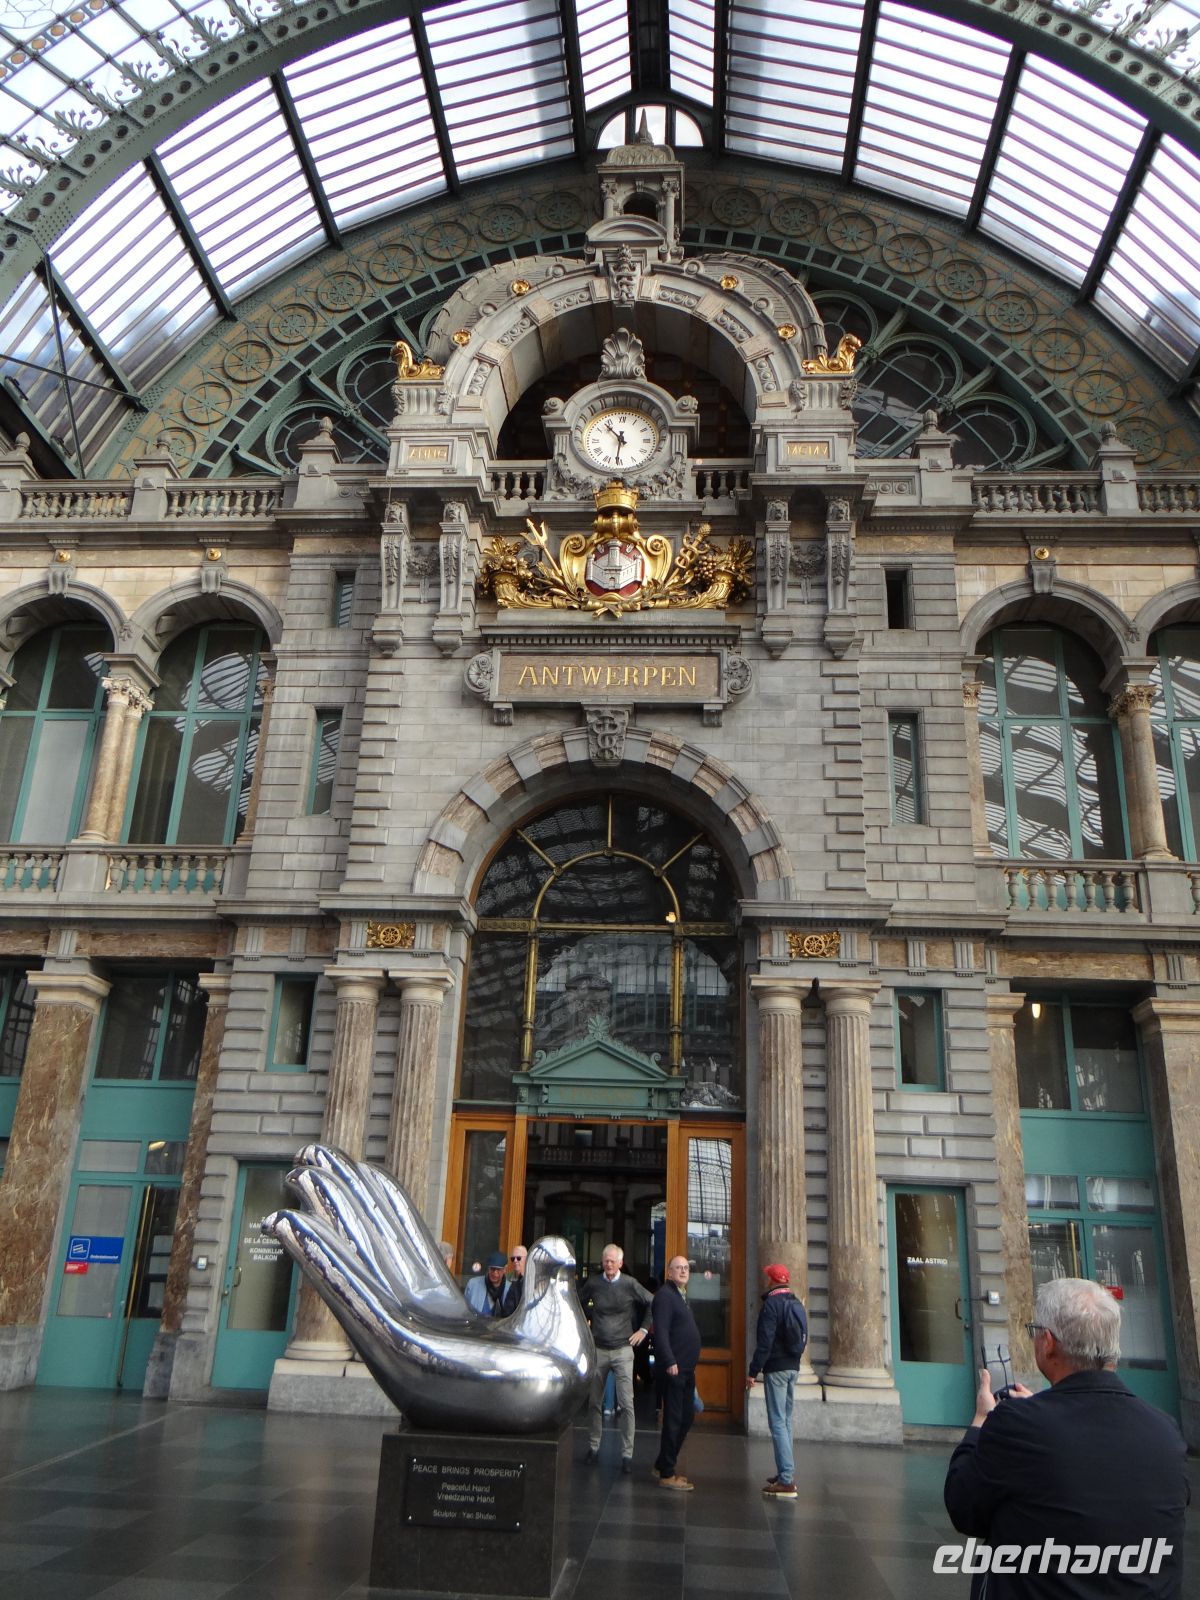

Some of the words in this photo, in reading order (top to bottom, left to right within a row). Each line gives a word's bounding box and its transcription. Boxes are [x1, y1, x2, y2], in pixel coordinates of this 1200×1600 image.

[518, 664, 697, 687] ANTWERPEN
[907, 1256, 924, 1264] ZAAL
[925, 1257, 948, 1265] ASTRID
[413, 1464, 438, 1473] PEACE
[441, 1465, 470, 1476] BRINGS
[474, 1467, 522, 1478] PROSPERITY
[441, 1482, 471, 1491] Peaceful
[472, 1484, 491, 1493] Hand
[437, 1492, 475, 1502] Vreedzame
[476, 1495, 495, 1504] Hand
[433, 1509, 457, 1519] Sculptor
